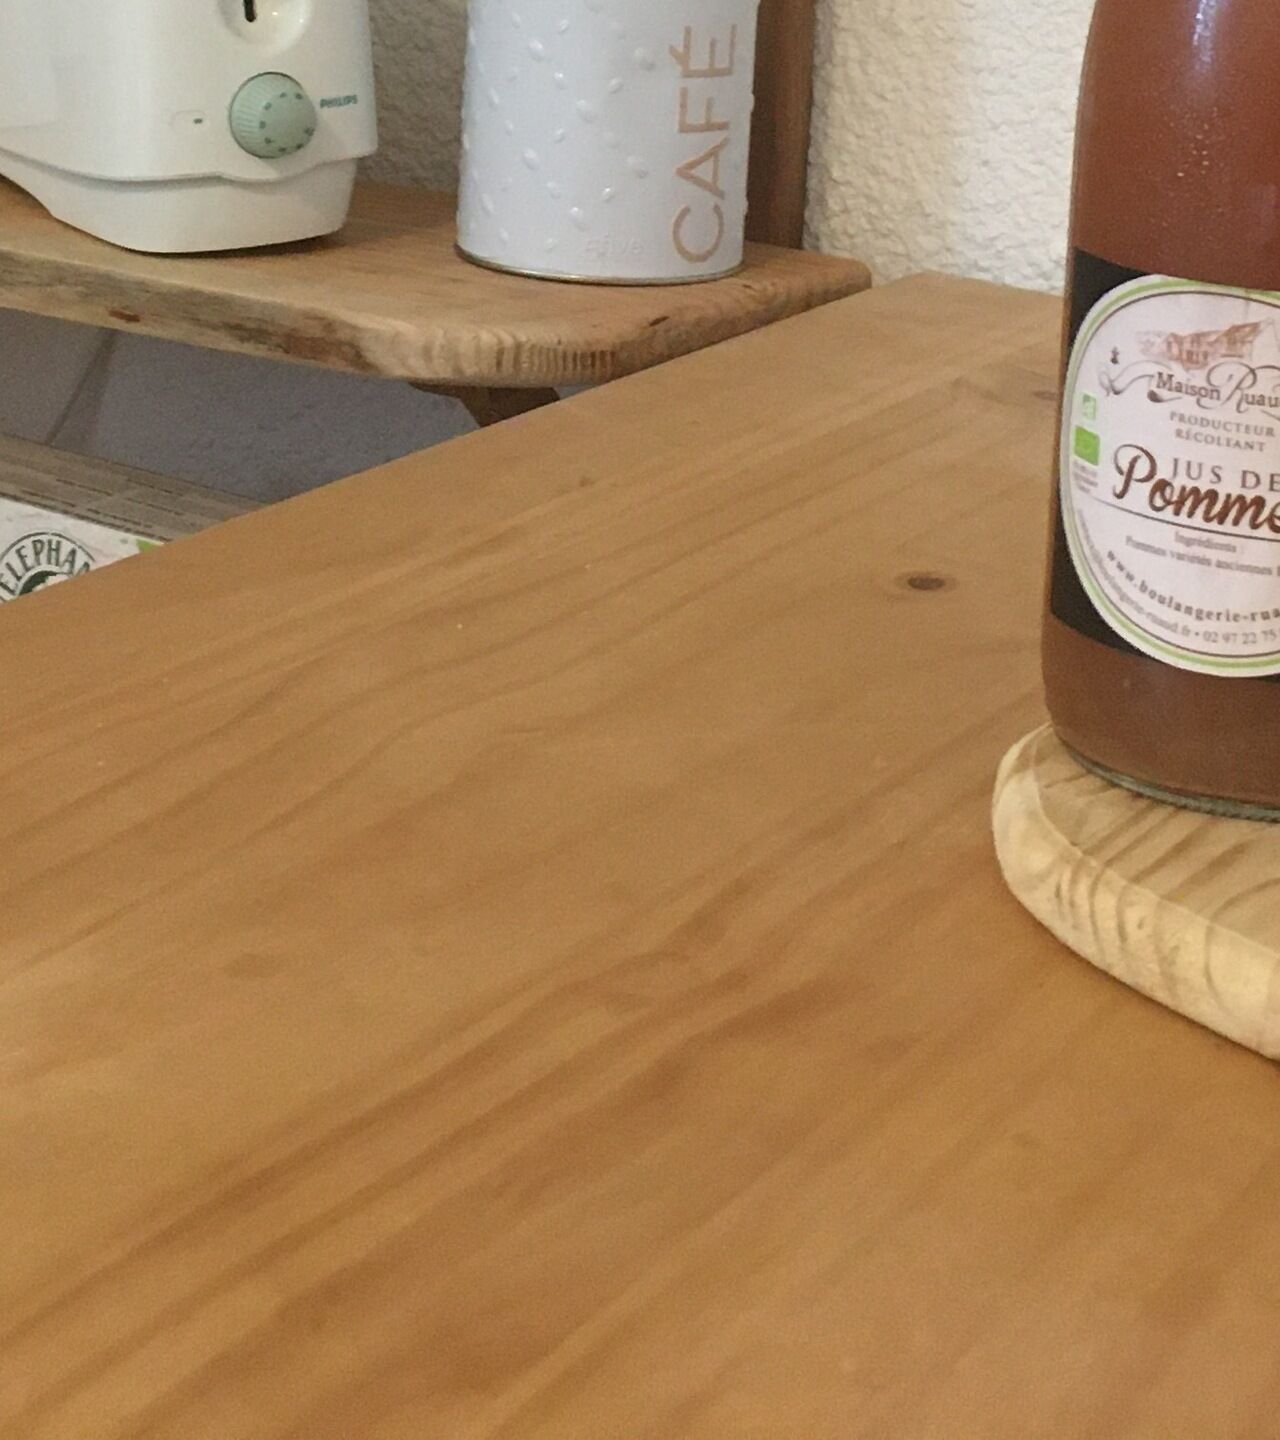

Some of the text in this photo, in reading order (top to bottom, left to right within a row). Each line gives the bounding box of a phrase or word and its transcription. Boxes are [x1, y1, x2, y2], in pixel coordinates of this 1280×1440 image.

[319, 94, 358, 109] PHILIPS
[669, 23, 737, 264] CAFÉ
[1155, 371, 1220, 401] Maison
[1169, 411, 1276, 438] PRODUCTEUR
[1174, 425, 1267, 452] RÉCOLTANT
[1171, 457, 1224, 484] JUS
